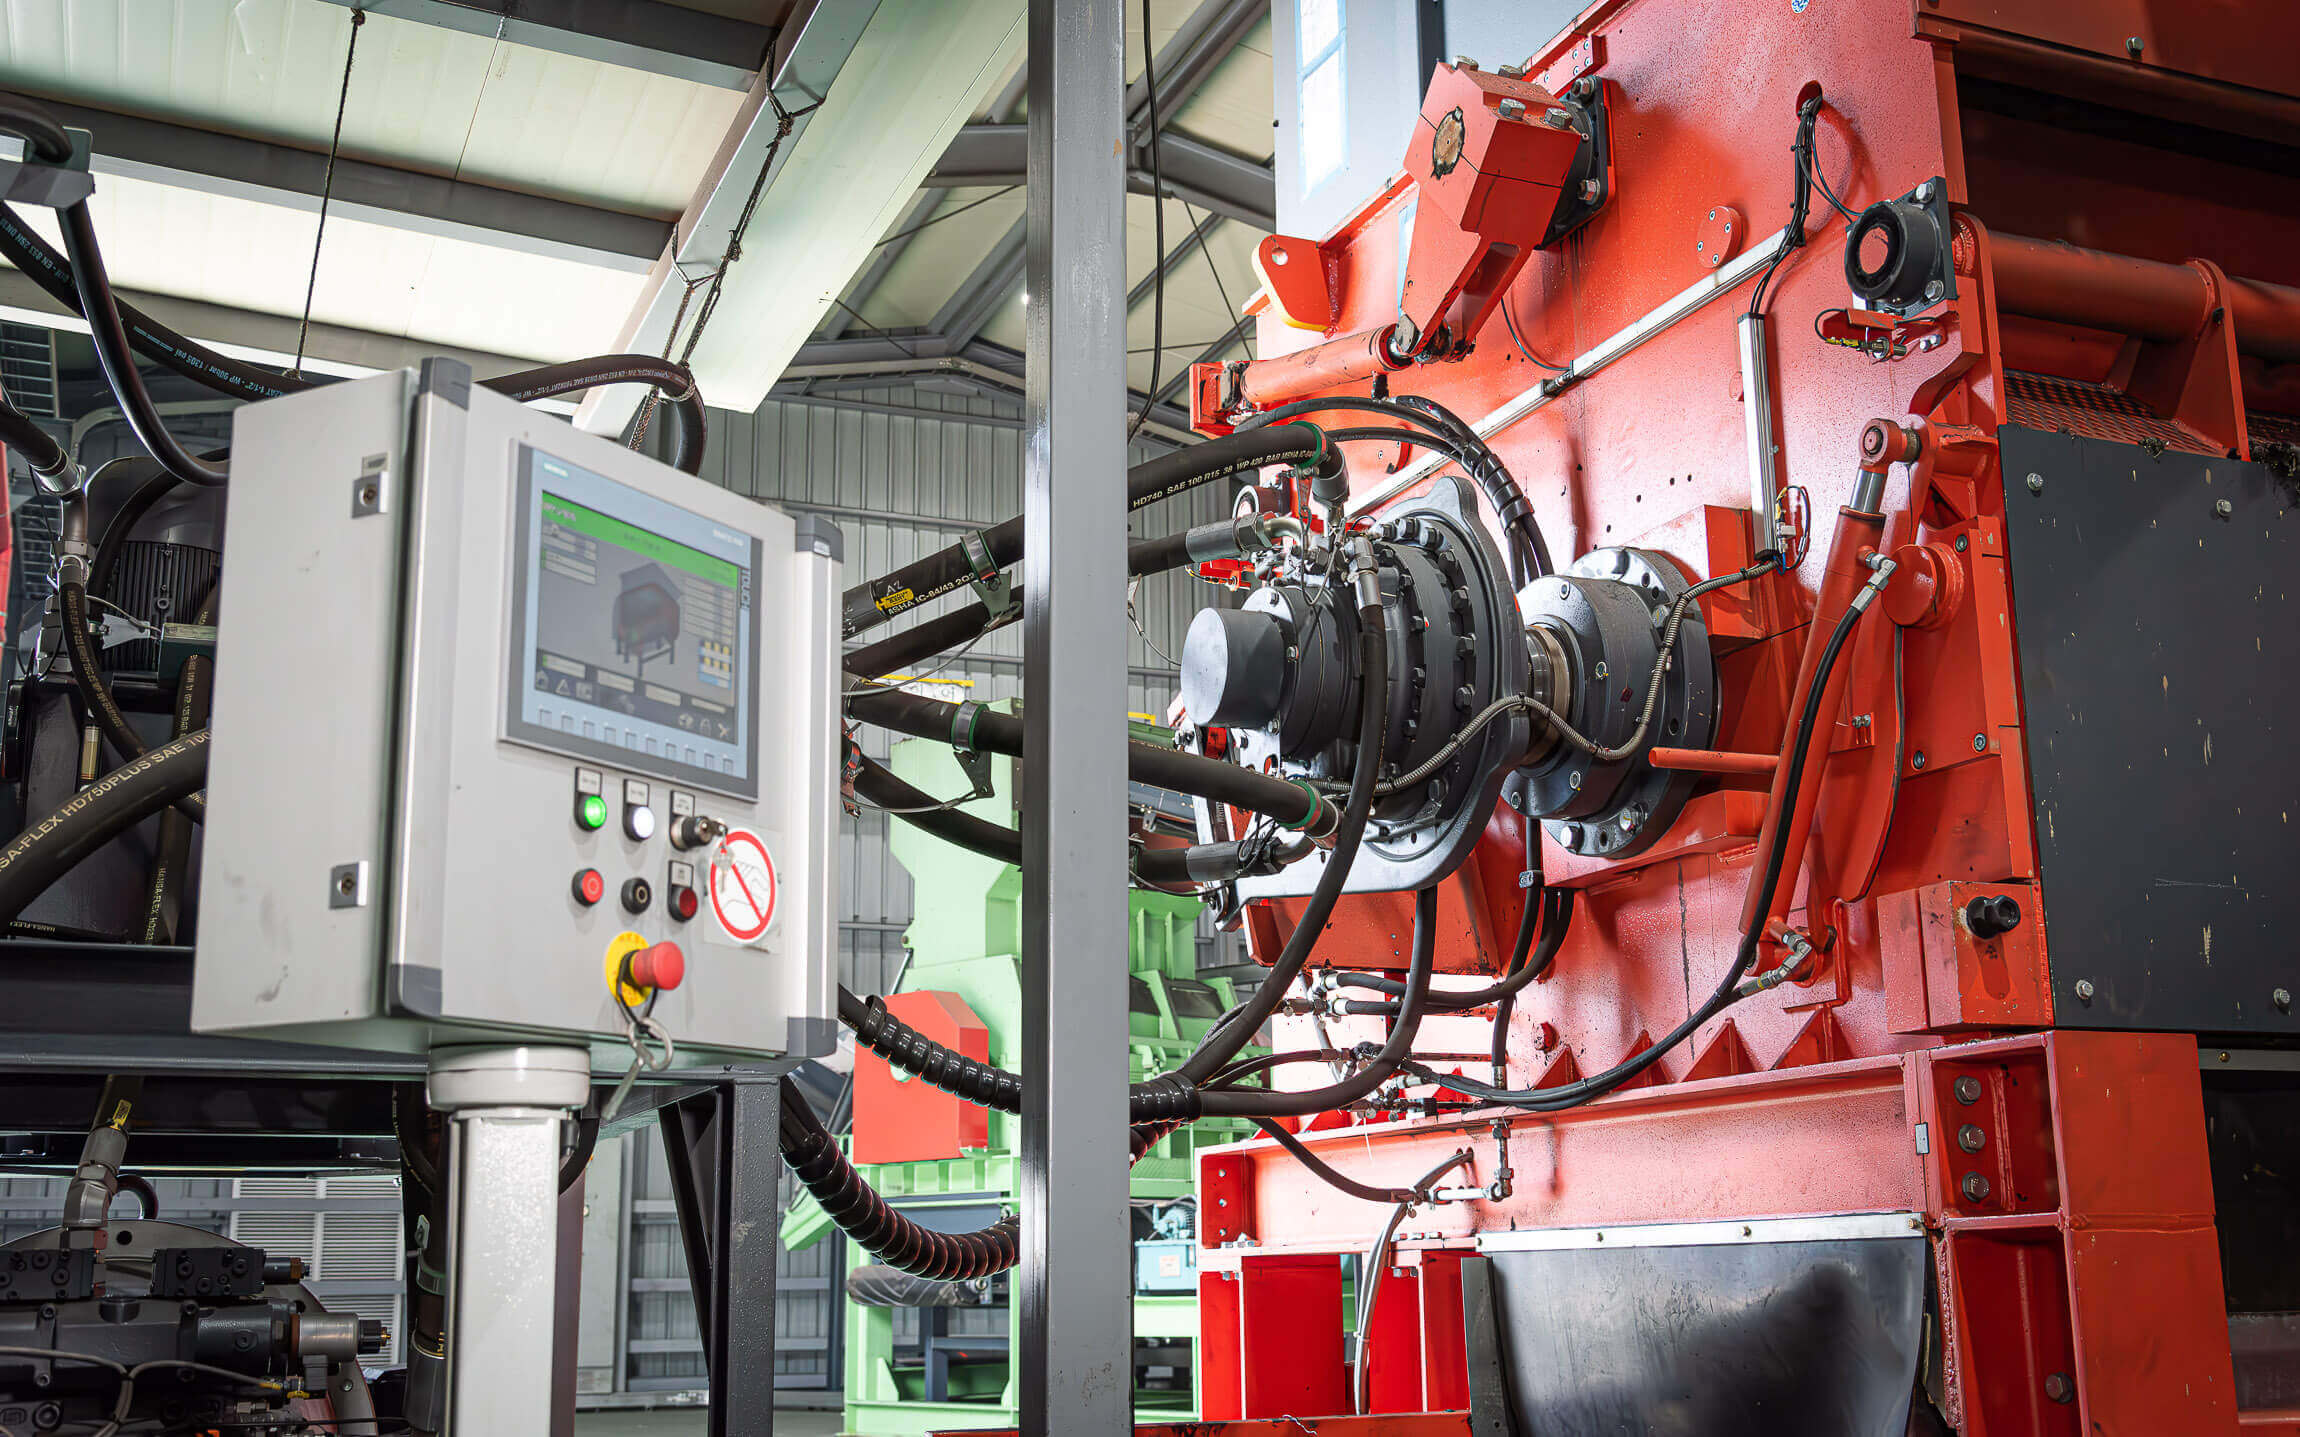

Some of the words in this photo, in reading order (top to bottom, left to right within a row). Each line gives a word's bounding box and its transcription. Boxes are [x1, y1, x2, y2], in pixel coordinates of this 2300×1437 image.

[186, 355, 204, 369] 1305
[1133, 489, 1164, 508] HD740
[1166, 481, 1187, 495] SAE
[1187, 475, 1203, 487] 100
[1236, 460, 1250, 471] WP
[739, 567, 752, 609] TOUCH
[61, 760, 152, 818] HD750PLUS
[151, 743, 186, 764] SAE
